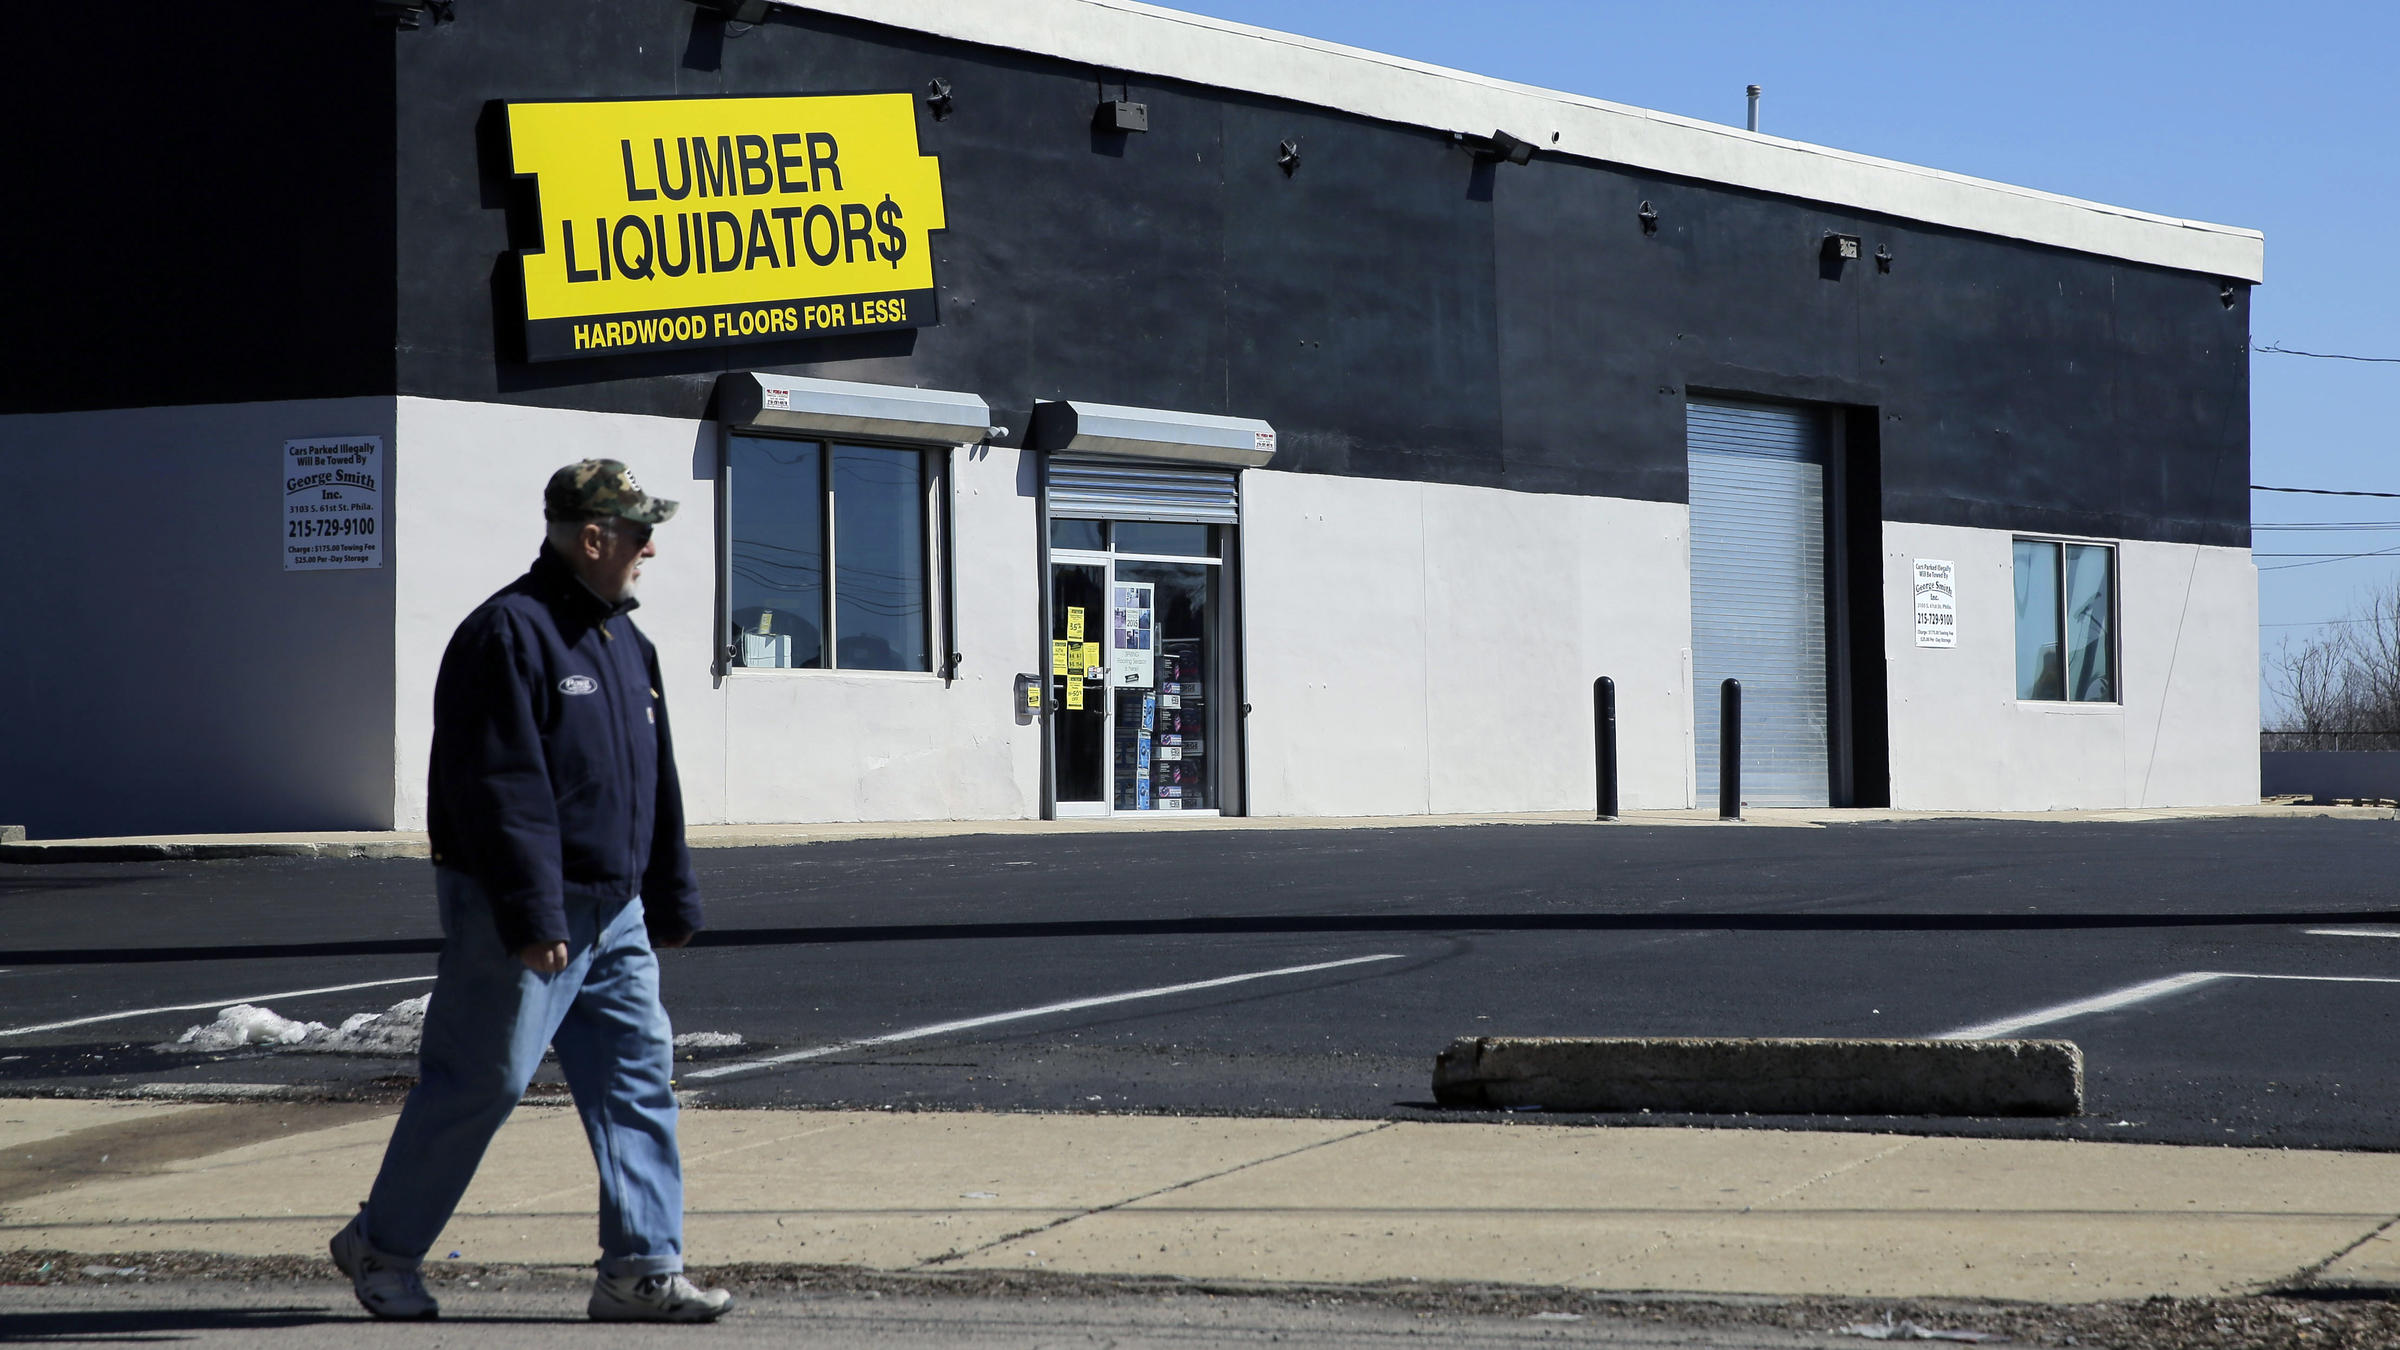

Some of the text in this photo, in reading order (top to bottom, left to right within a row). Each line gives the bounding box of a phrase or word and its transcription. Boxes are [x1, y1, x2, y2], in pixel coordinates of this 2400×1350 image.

[620, 132, 843, 202] LUMBER
[561, 193, 907, 283] LIQUIDATOR$
[574, 298, 907, 350] HARDWOOD FLOORS FOR LESS!
[289, 443, 375, 456] Cars Parked Illegally
[297, 454, 367, 466] Will Be Towed By
[286, 469, 375, 491] George Smith
[321, 489, 343, 500] Inc.
[289, 503, 374, 514] 3103 S. 61st St. Phila.
[288, 517, 375, 538] 215-729-9100
[1916, 580, 1952, 595] George Smith
[1917, 612, 1954, 626] 215-729-9100
